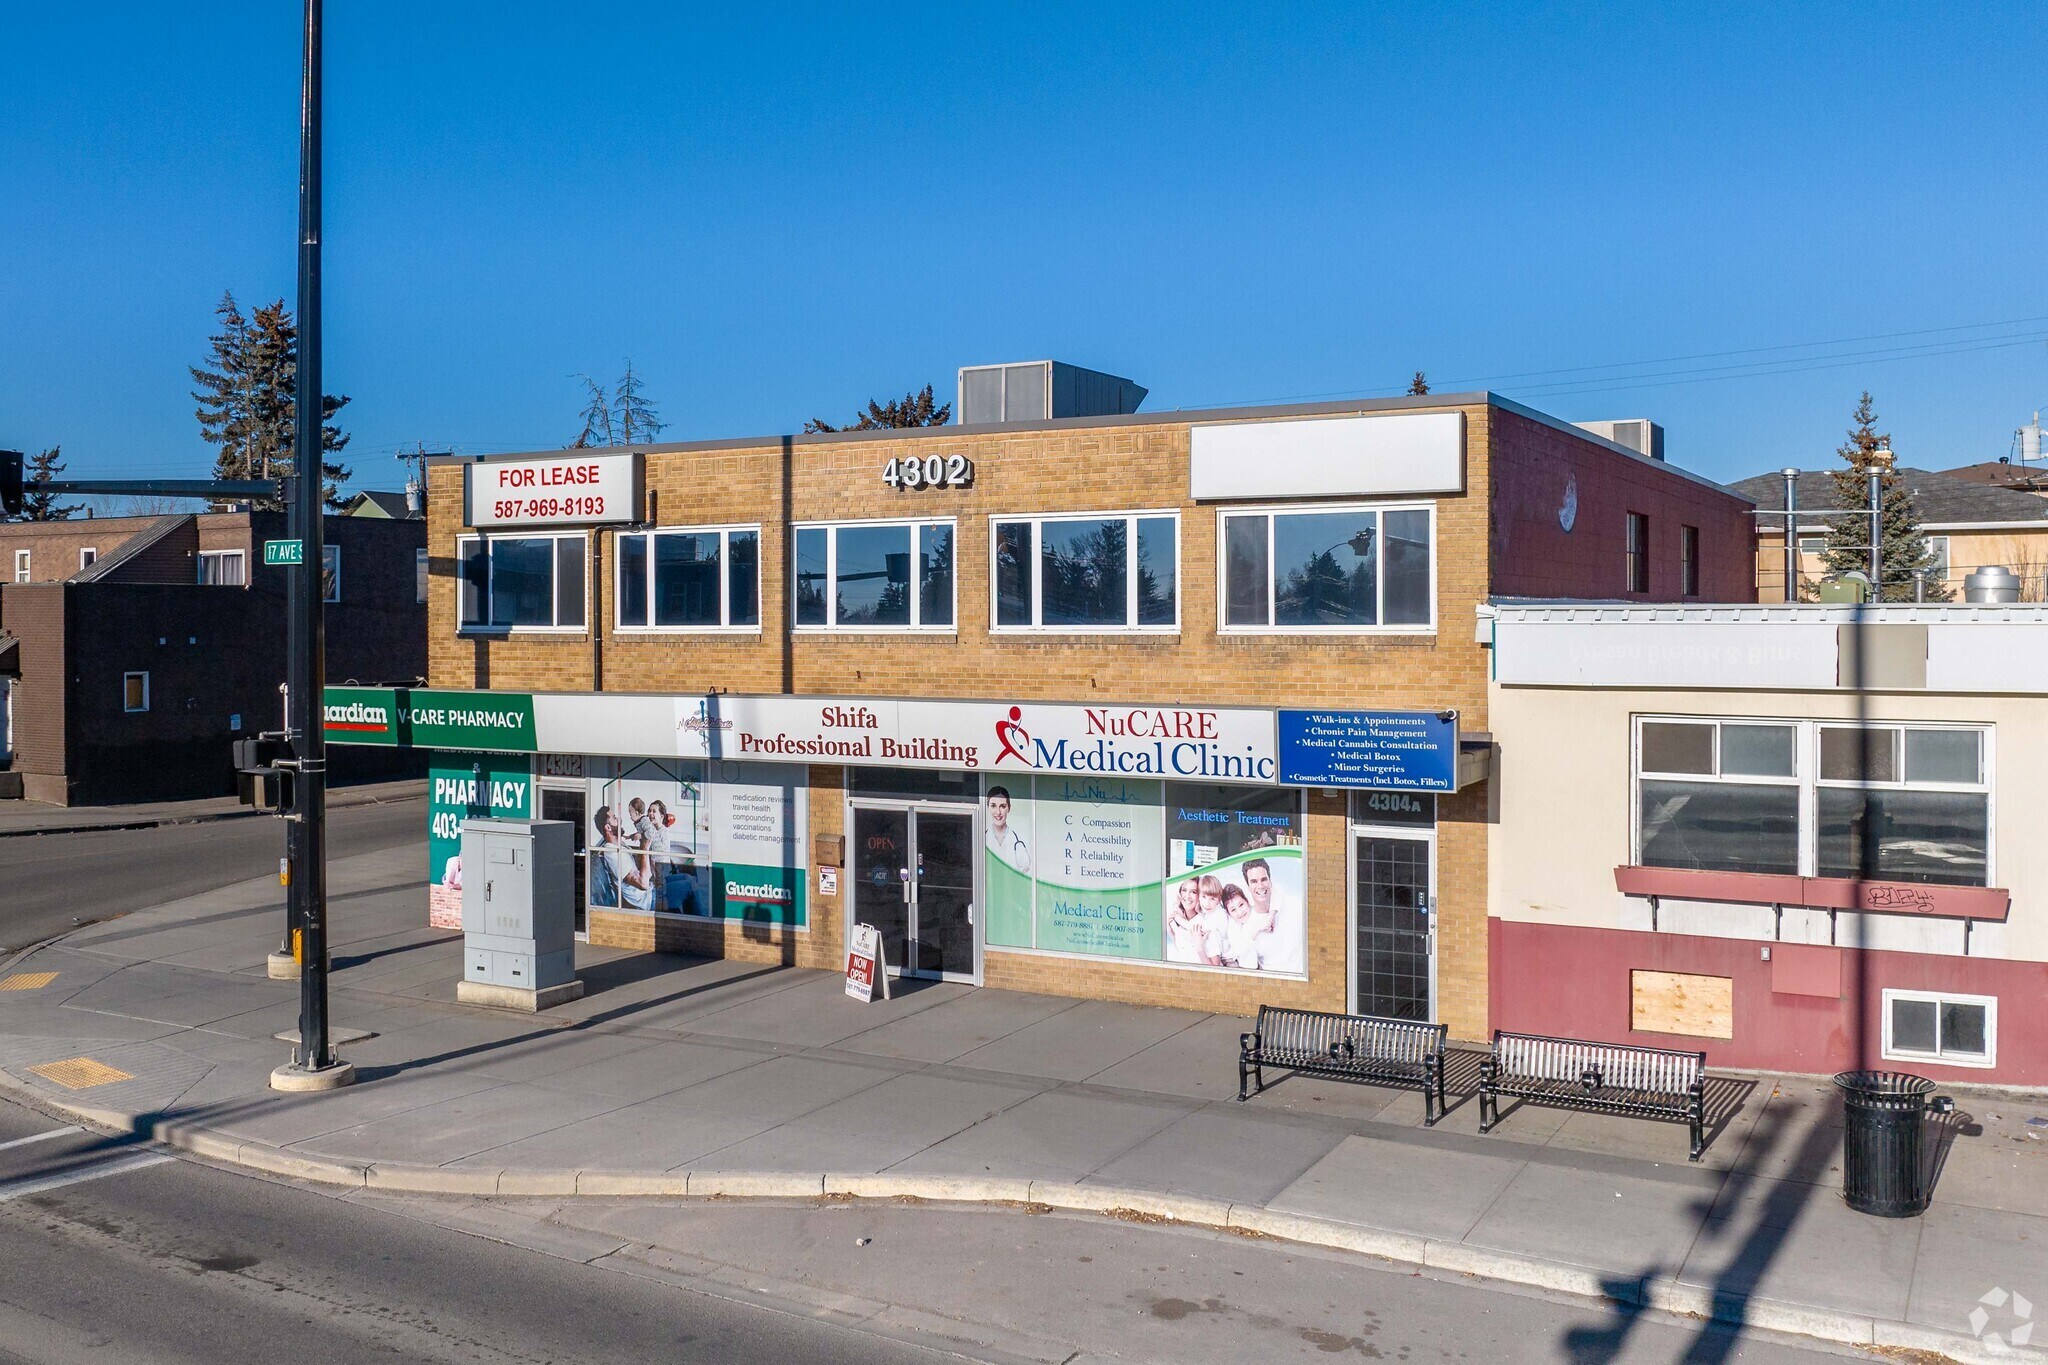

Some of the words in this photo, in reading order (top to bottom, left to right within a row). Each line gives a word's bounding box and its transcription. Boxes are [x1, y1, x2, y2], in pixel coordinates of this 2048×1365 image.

[500, 469, 535, 487] FOR
[541, 466, 600, 486] LEASE
[882, 454, 965, 487] 4302
[494, 497, 604, 518] 587-969-8193
[268, 545, 277, 560] 17
[279, 545, 296, 560] AVE
[323, 702, 388, 723] ardian
[397, 708, 445, 725] V-CARE
[448, 710, 524, 728] PHARMACY
[821, 706, 878, 729] Shifa
[1084, 709, 1219, 740] NuCARE
[1312, 715, 1351, 724] Walk-ins
[1353, 716, 1361, 724] &
[1363, 716, 1426, 727] Appointments
[1311, 728, 1345, 736] Chronic
[1347, 728, 1367, 736] Pain
[1369, 728, 1427, 739] Management
[739, 733, 872, 757] Professional
[880, 737, 978, 767] Building
[1302, 739, 1336, 748] Medical
[1338, 740, 1378, 749] Cannabis
[1380, 741, 1438, 750] Consultation
[1032, 738, 1166, 774] Medical
[1171, 743, 1275, 779] Clinic
[1337, 752, 1372, 760] Medical
[1374, 752, 1401, 761] Botox
[472, 762, 481, 773] &
[1334, 762, 1361, 771] Minor
[1363, 764, 1405, 774] Surgeries
[1294, 774, 1327, 782] Cosmetic
[1329, 775, 1371, 783] Treatments
[1393, 778, 1419, 786] Botox,
[1420, 778, 1448, 788] Fillers)
[435, 778, 526, 808] PHARMACY
[732, 794, 766, 802] medication
[1088, 785, 1106, 799] Nu
[732, 803, 750, 811] travel
[751, 804, 771, 812] health
[1368, 793, 1421, 812] 4304A
[732, 813, 775, 824] compounding
[1064, 815, 1073, 825] C
[1081, 816, 1131, 829] Compassion
[1177, 808, 1229, 823] Aesthetic
[1235, 811, 1290, 826] Treatment
[732, 823, 772, 832] vaccinations
[732, 832, 758, 841] diabetic
[758, 834, 801, 844] management
[868, 837, 895, 850] OPEN
[1065, 832, 1073, 841] A
[1080, 833, 1131, 847] Accessibility
[1065, 848, 1073, 858] R
[1080, 849, 1124, 864] Reliability
[1065, 865, 1071, 875] E
[1081, 866, 1124, 879] Excellence
[725, 881, 792, 900] Guardian
[1054, 901, 1102, 918] Medical
[1106, 905, 1144, 921] Clinic
[853, 956, 868, 970] NOW
